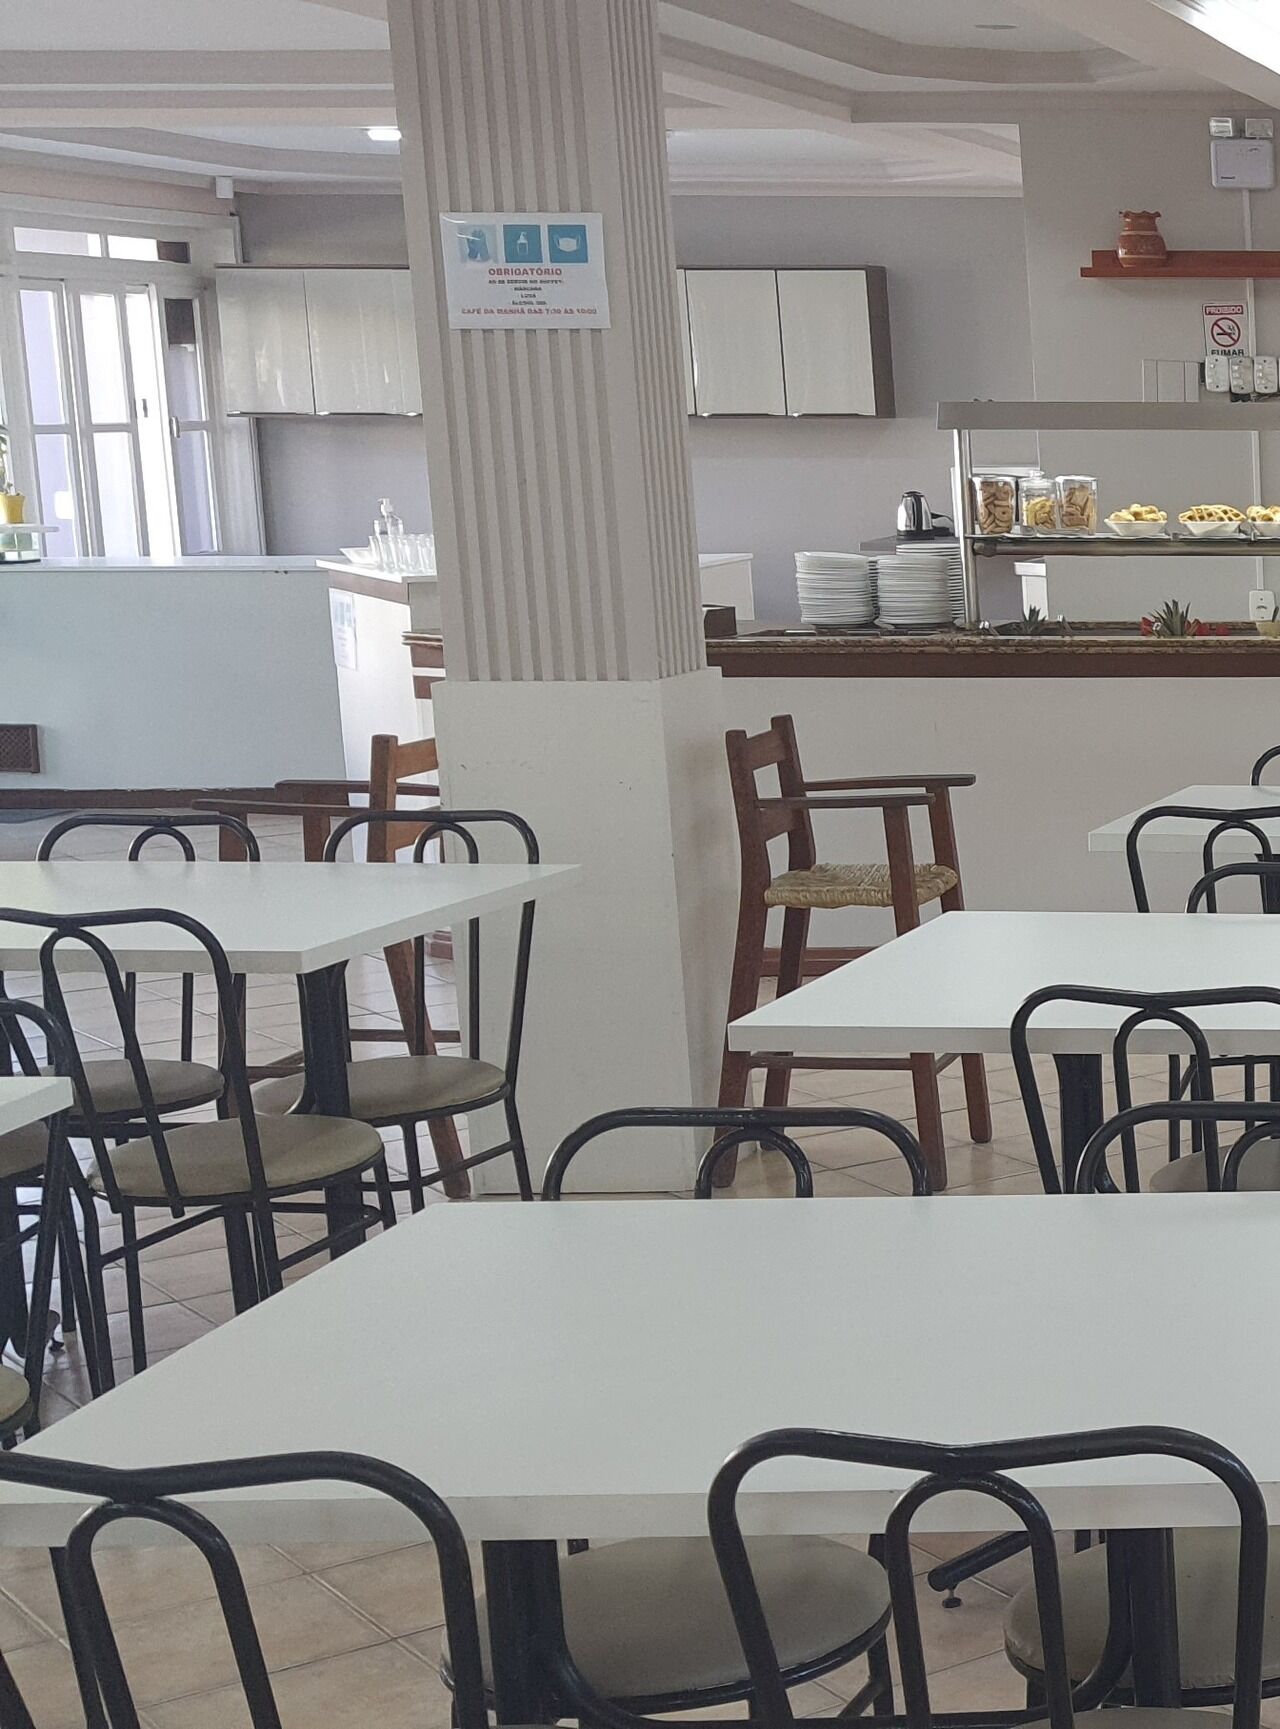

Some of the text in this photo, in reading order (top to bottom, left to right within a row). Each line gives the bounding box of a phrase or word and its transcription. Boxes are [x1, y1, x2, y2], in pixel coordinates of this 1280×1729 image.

[488, 267, 562, 276] OBRIGATÓRIO
[461, 307, 481, 315] CAFÉ
[496, 307, 526, 315] MANHÃ
[1206, 306, 1242, 315] PROIBIDO
